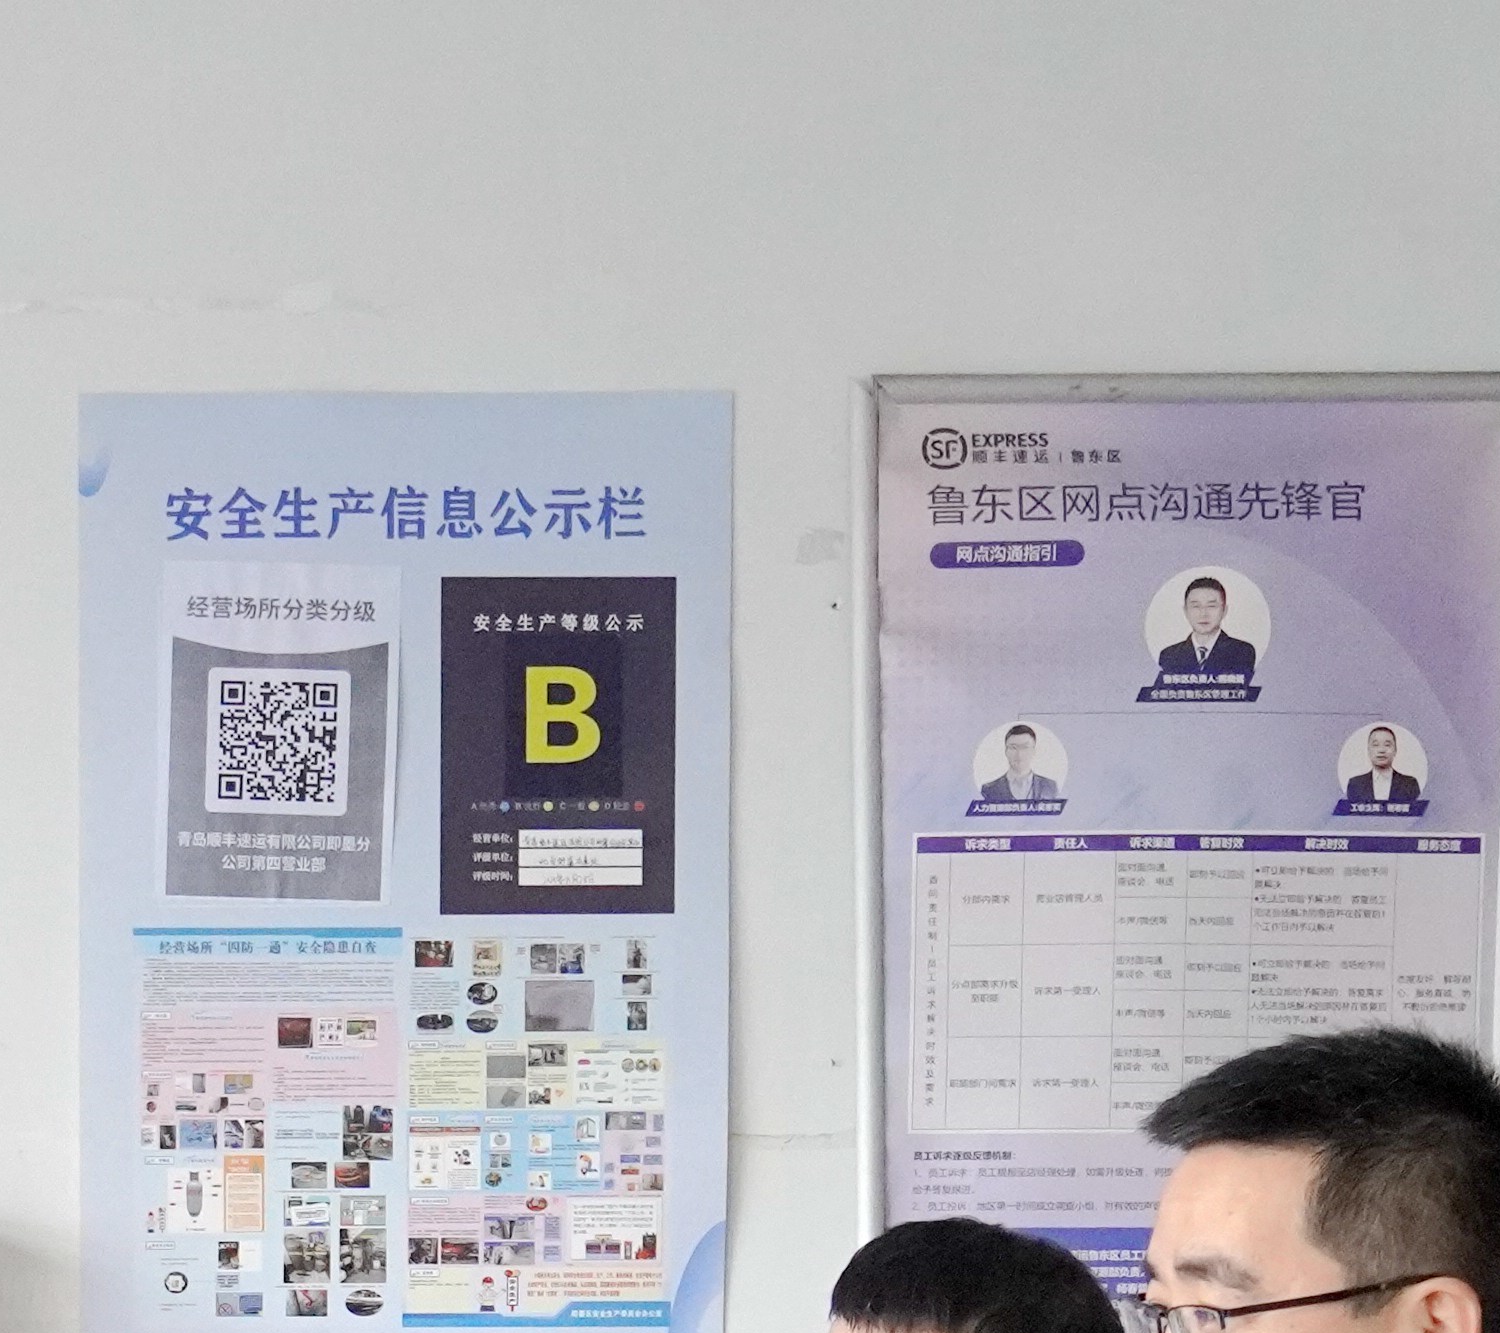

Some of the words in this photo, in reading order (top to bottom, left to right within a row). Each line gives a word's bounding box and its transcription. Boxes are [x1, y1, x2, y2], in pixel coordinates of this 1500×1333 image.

[972, 433, 1049, 449] EXPRESS
[972, 449, 1050, 465] 顺丰速运
[927, 481, 1366, 525] 鲁东区网点沟通先锋官
[166, 486, 647, 542] 安全生产信息公示栏
[956, 544, 1058, 563] 网点沟通指引
[186, 595, 377, 623] 经营场所分类分级
[473, 612, 645, 633] 安全生产等级公示
[524, 665, 601, 765] B
[177, 831, 371, 852] 青岛顺丰速运有限公司即墨分
[965, 839, 1011, 851] 诉求类型
[1054, 837, 1088, 850] 责任人
[1305, 837, 1348, 850] 解决时效
[221, 854, 327, 873] 公司第四营业部
